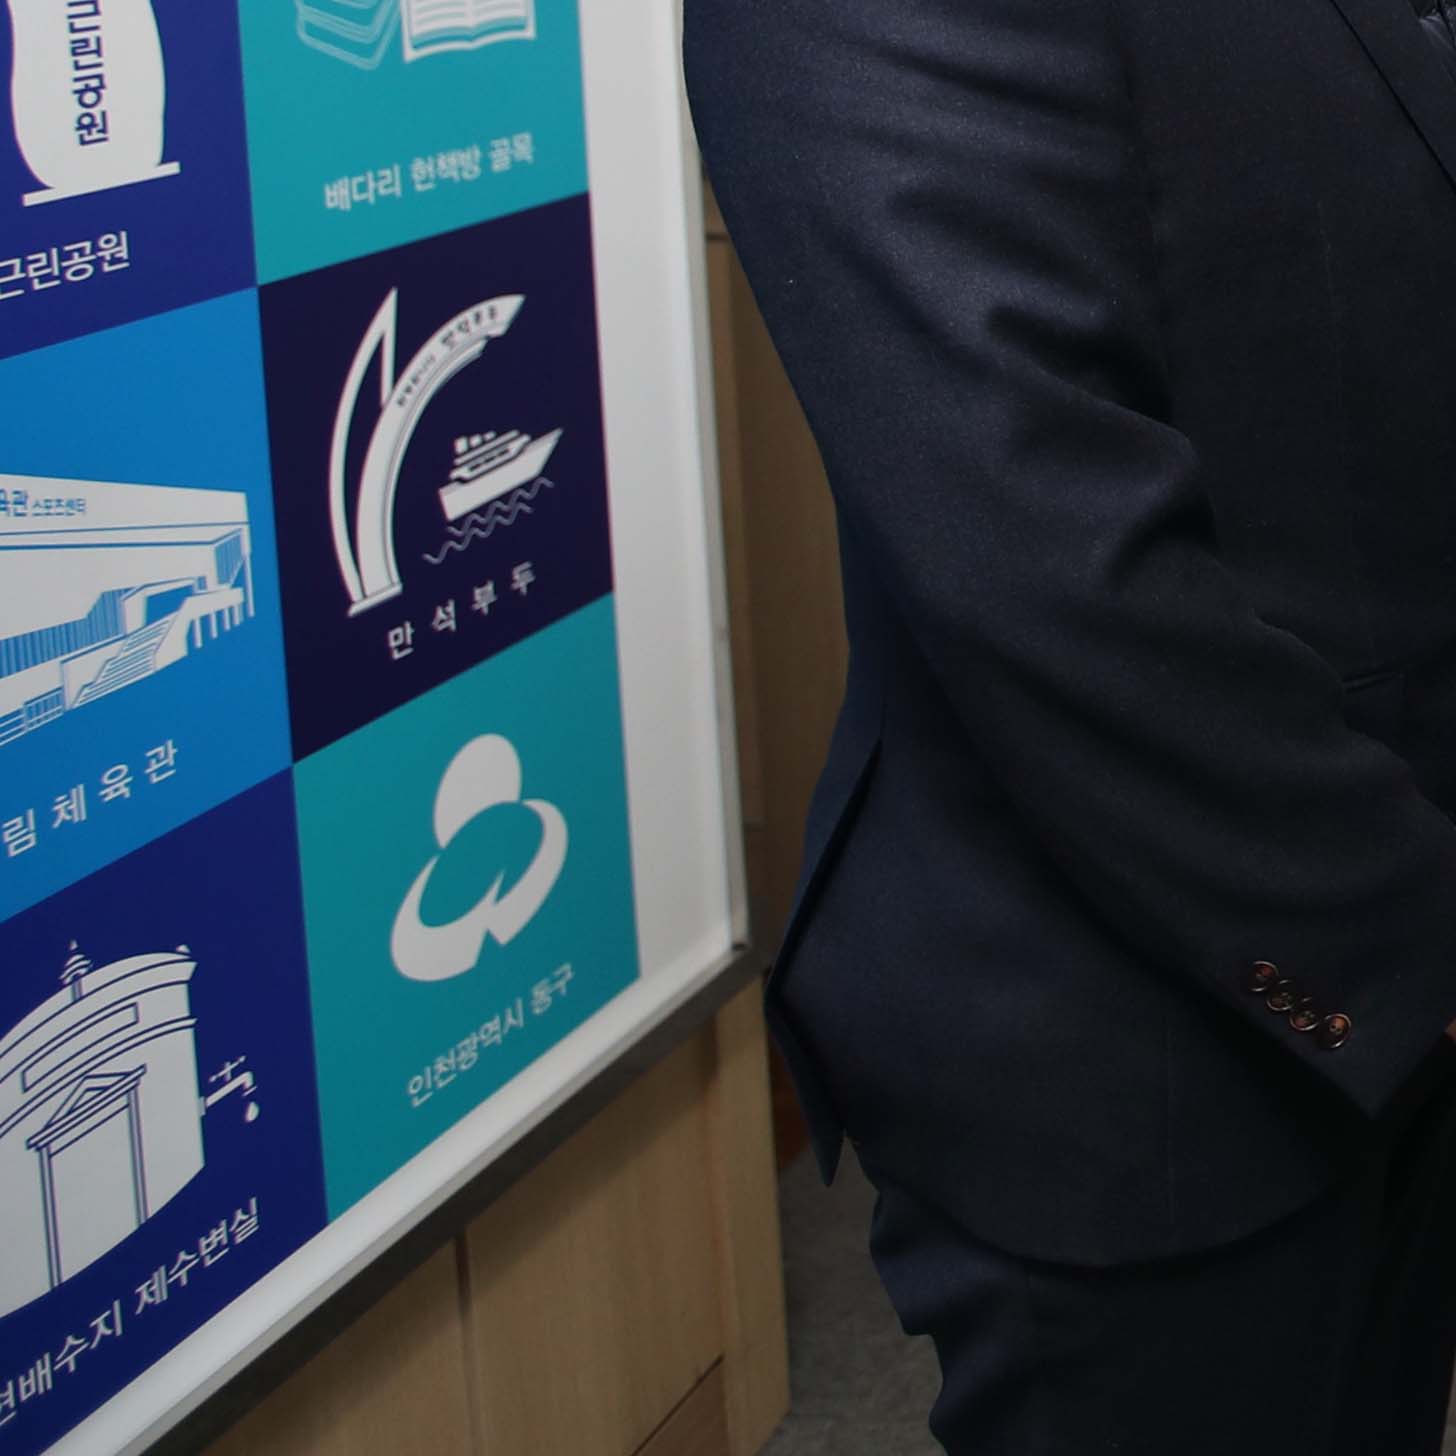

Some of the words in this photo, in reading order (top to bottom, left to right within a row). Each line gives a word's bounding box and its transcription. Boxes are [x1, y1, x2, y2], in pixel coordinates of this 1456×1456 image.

[323, 164, 402, 211] 배다리
[411, 144, 481, 192] 헌책방
[489, 131, 534, 174] 골목
[0, 230, 131, 301] 근린공원
[406, 998, 524, 1108] 인천광역시
[530, 962, 575, 1015] 동구
[134, 1197, 260, 1316] 제수변실
